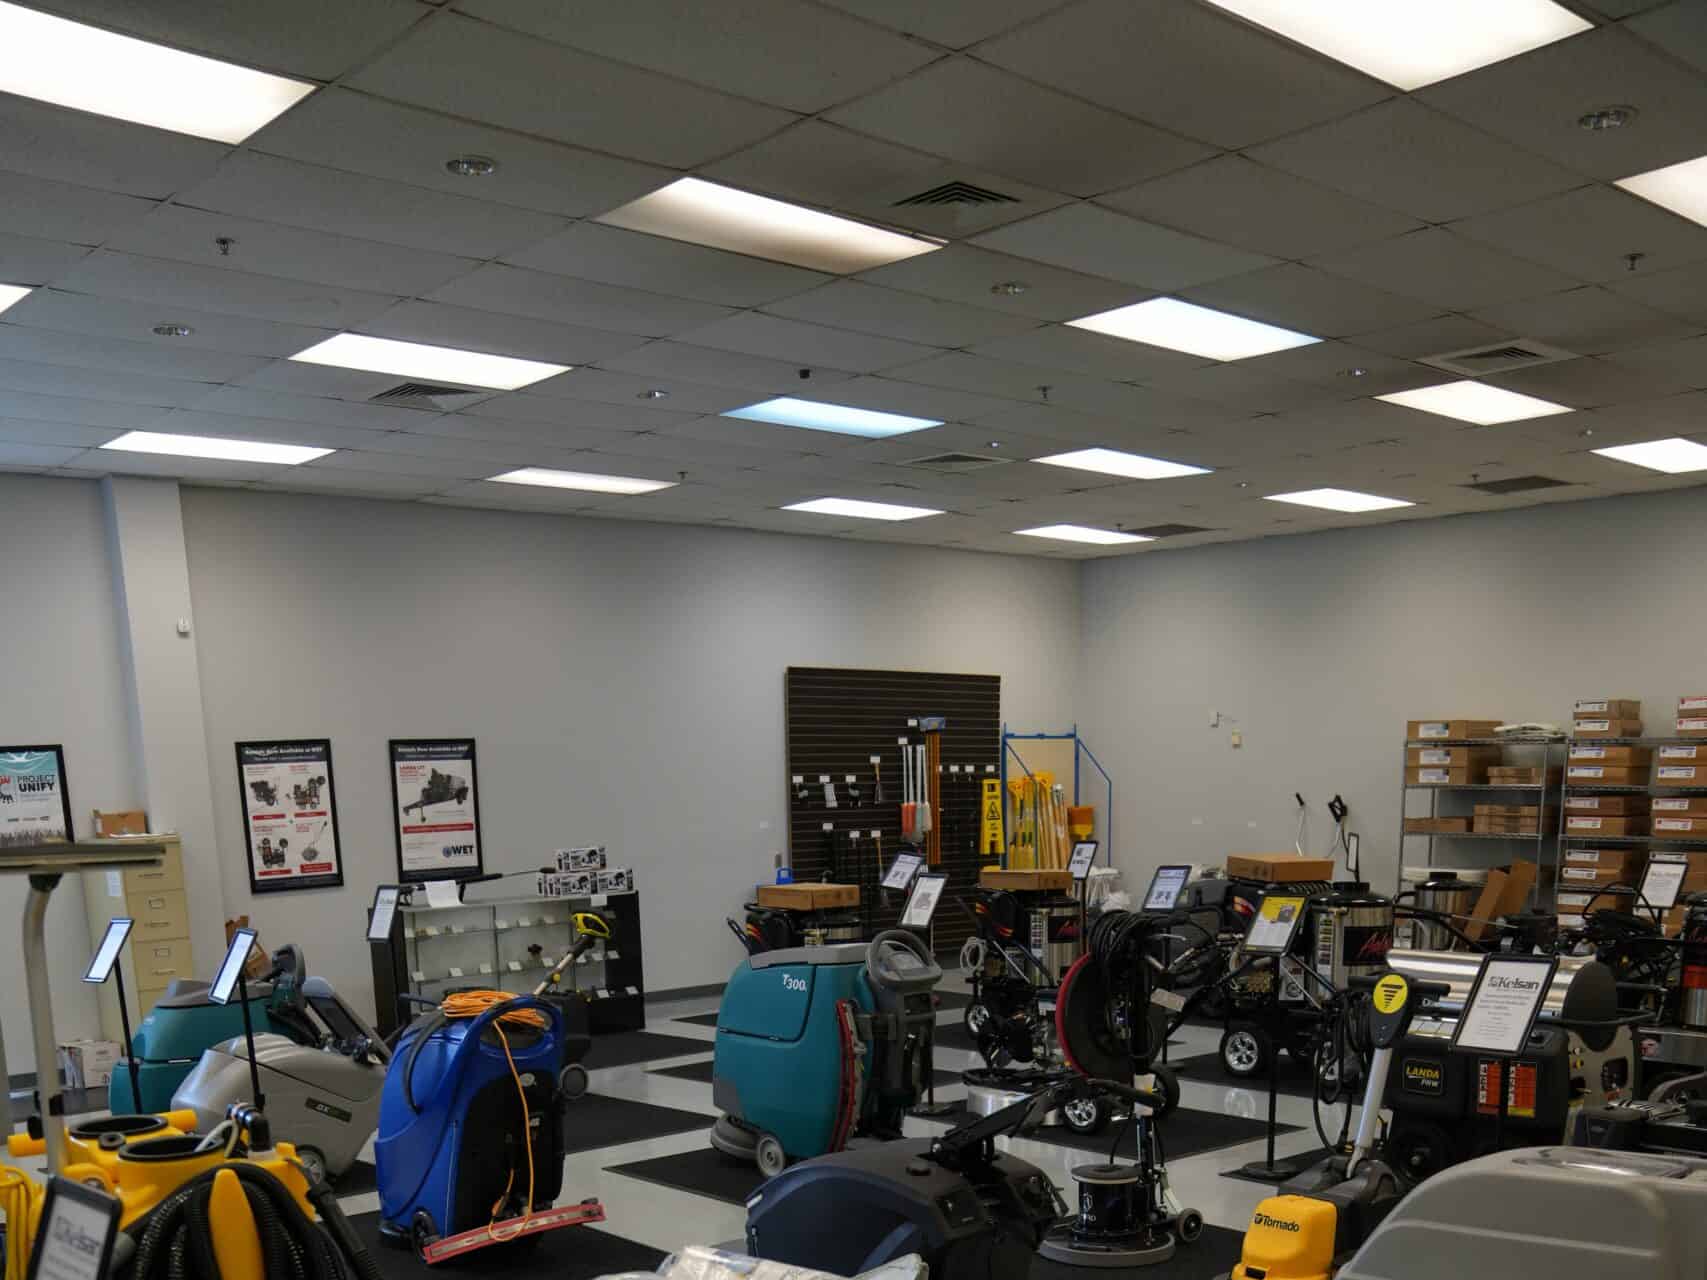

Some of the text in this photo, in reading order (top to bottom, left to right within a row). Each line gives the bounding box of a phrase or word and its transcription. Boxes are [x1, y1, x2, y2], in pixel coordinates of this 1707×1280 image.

[17, 774, 55, 784] PROJECT
[19, 782, 54, 793] UNIFY
[451, 845, 474, 855] WET
[1498, 976, 1539, 990] Kelsan
[1406, 1066, 1440, 1079] LANDA
[1264, 1215, 1300, 1232] Tornado
